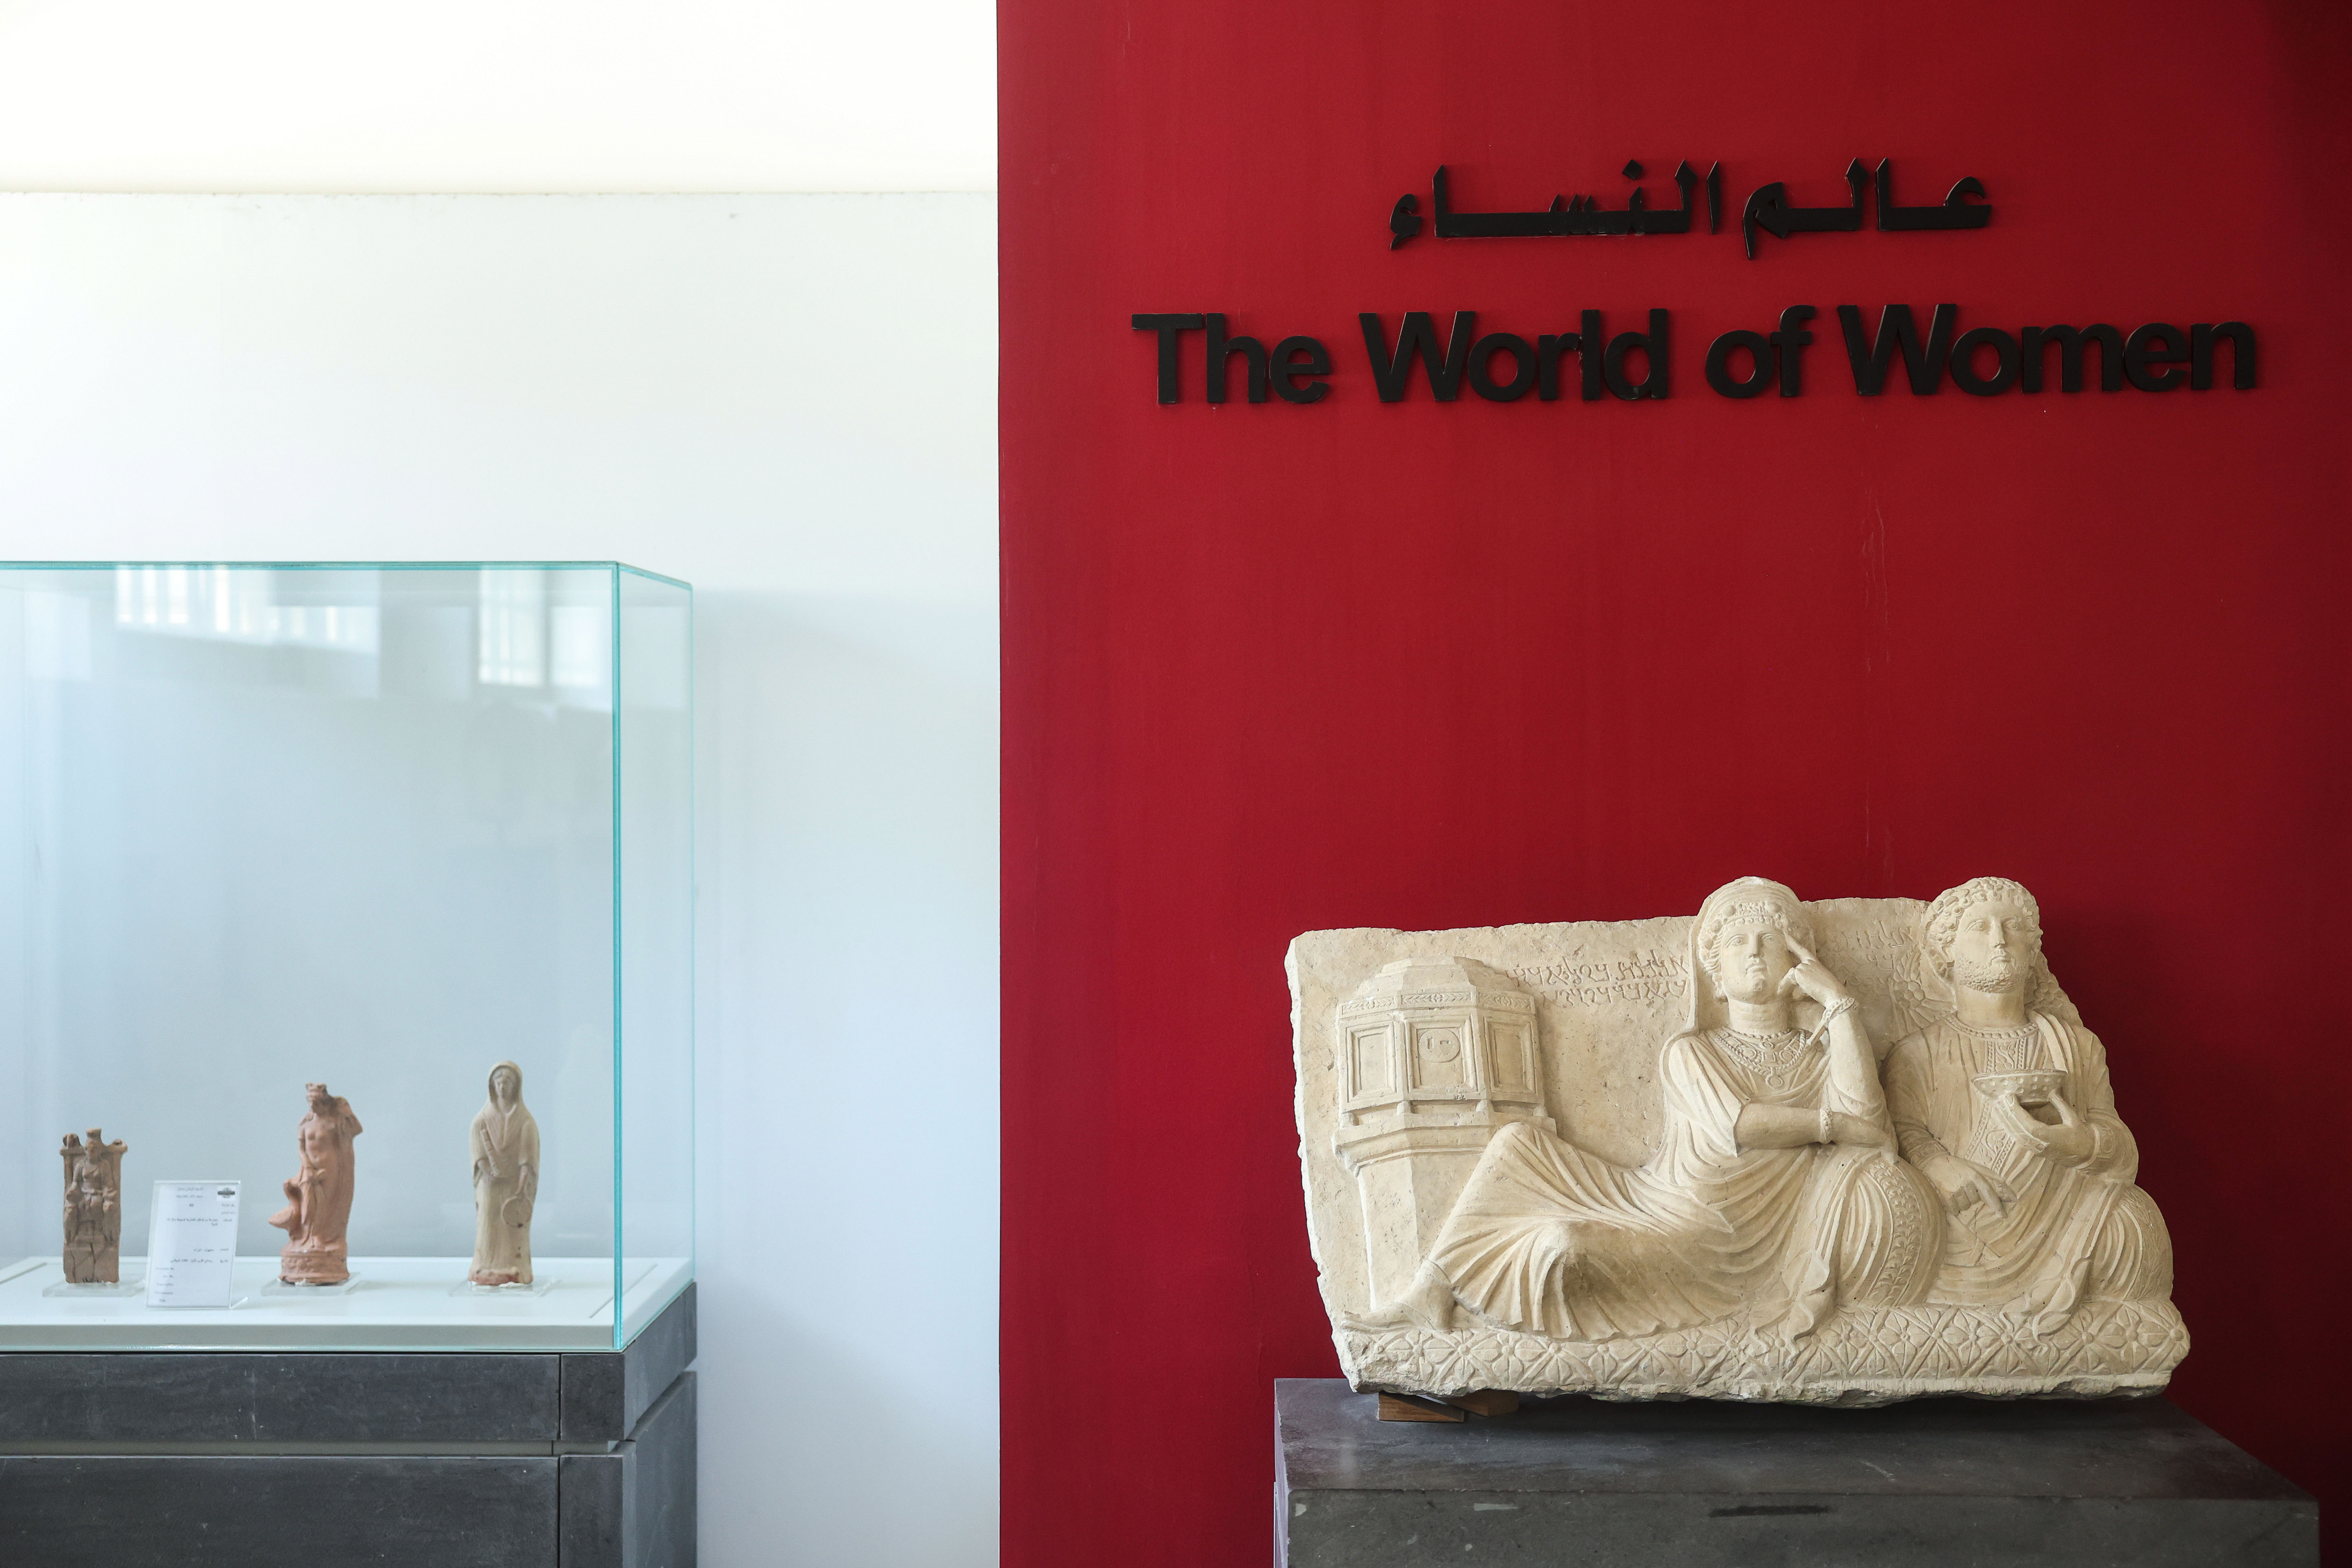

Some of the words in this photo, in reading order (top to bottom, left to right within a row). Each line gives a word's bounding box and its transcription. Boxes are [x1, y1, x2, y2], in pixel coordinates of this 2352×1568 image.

[1390, 159, 1722, 250] النساء
[1742, 158, 1992, 259] عالم
[1132, 313, 1332, 404] The
[1359, 309, 1669, 402] World
[1705, 305, 1816, 399] of
[1837, 304, 2257, 397] Women
